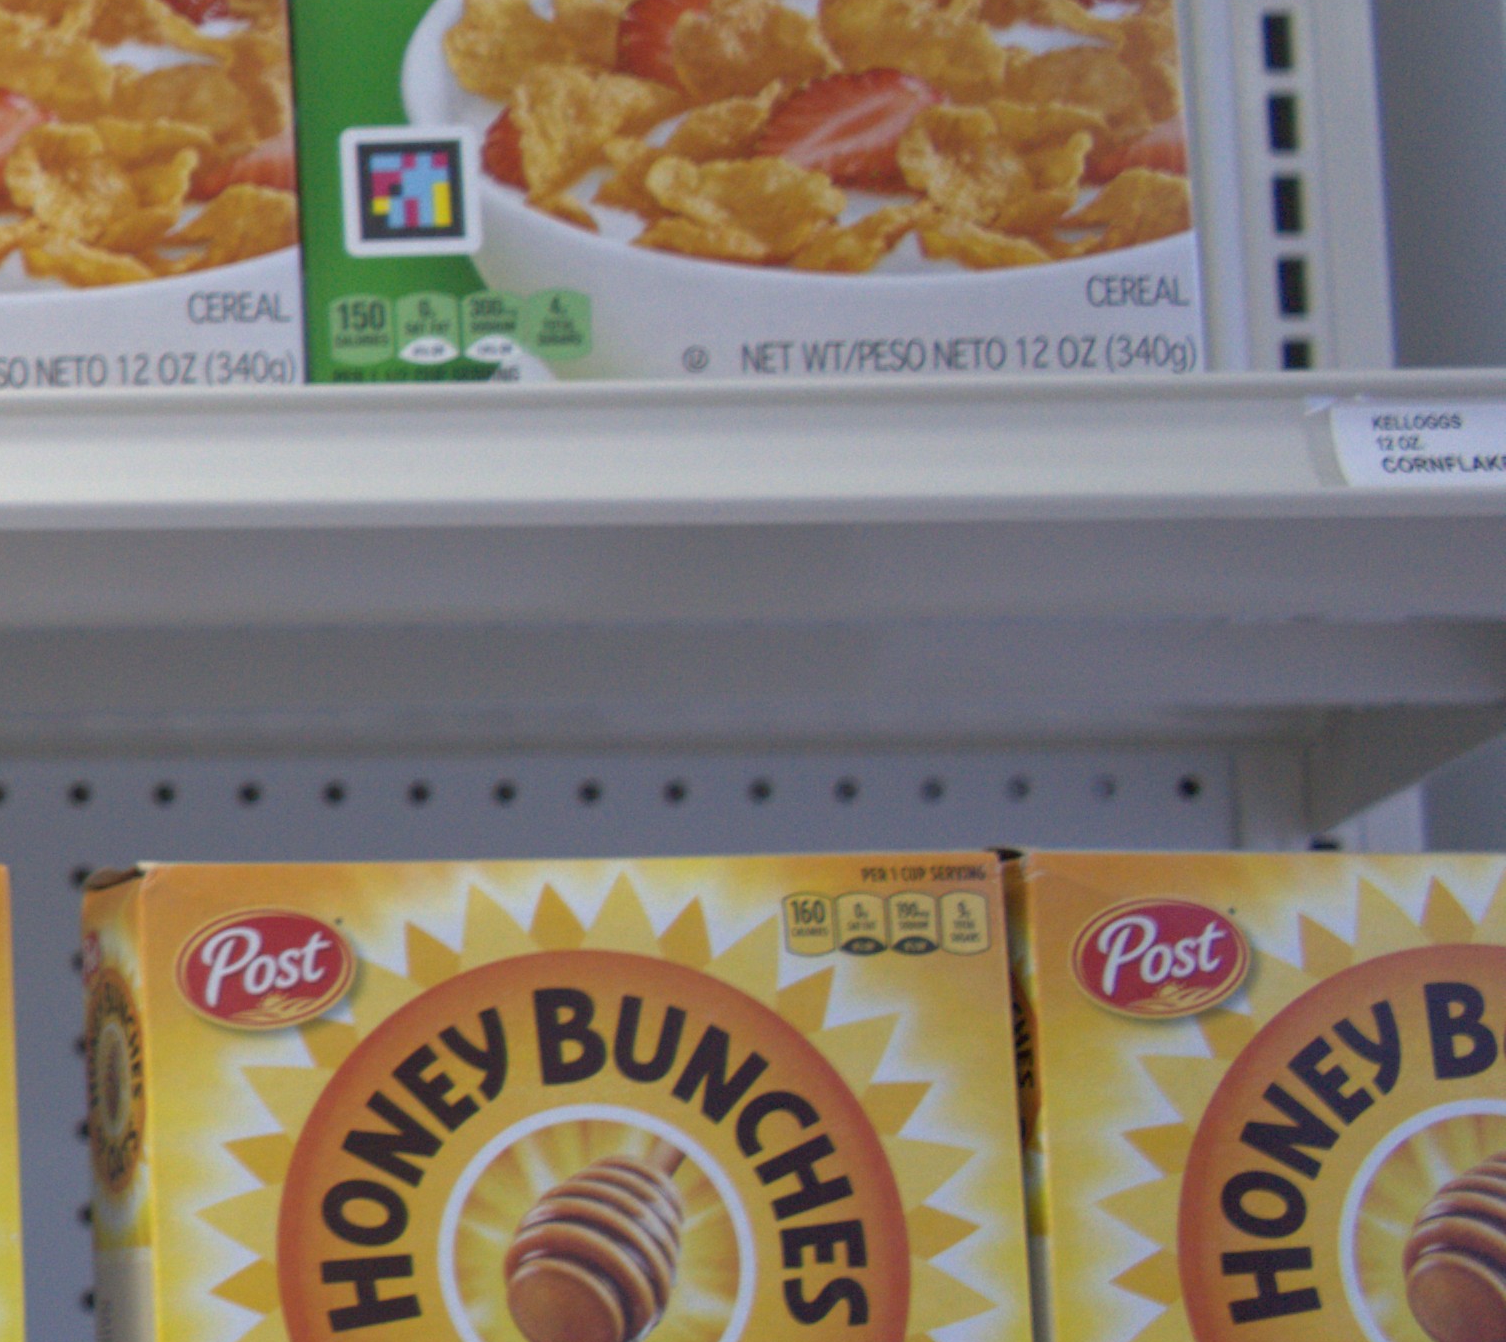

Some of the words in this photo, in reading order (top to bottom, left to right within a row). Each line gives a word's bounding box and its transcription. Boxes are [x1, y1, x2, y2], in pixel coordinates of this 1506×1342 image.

[336, 301, 386, 331] 150
[1087, 275, 1189, 309] CEREAL
[741, 341, 800, 375] NET
[810, 338, 926, 375] WT/PESO
[932, 338, 1006, 371] NETO
[1017, 337, 1049, 370] 12
[1059, 337, 1098, 370] OZ
[1107, 334, 1197, 373] (340g)
[1372, 414, 1463, 432] KELLOGGS
[200, 925, 328, 1007] Post
[1097, 916, 1227, 996] Post
[320, 1006, 508, 1333] HONEY
[533, 987, 870, 1327] BUNCHES
[1220, 999, 1403, 1326] HONEY
